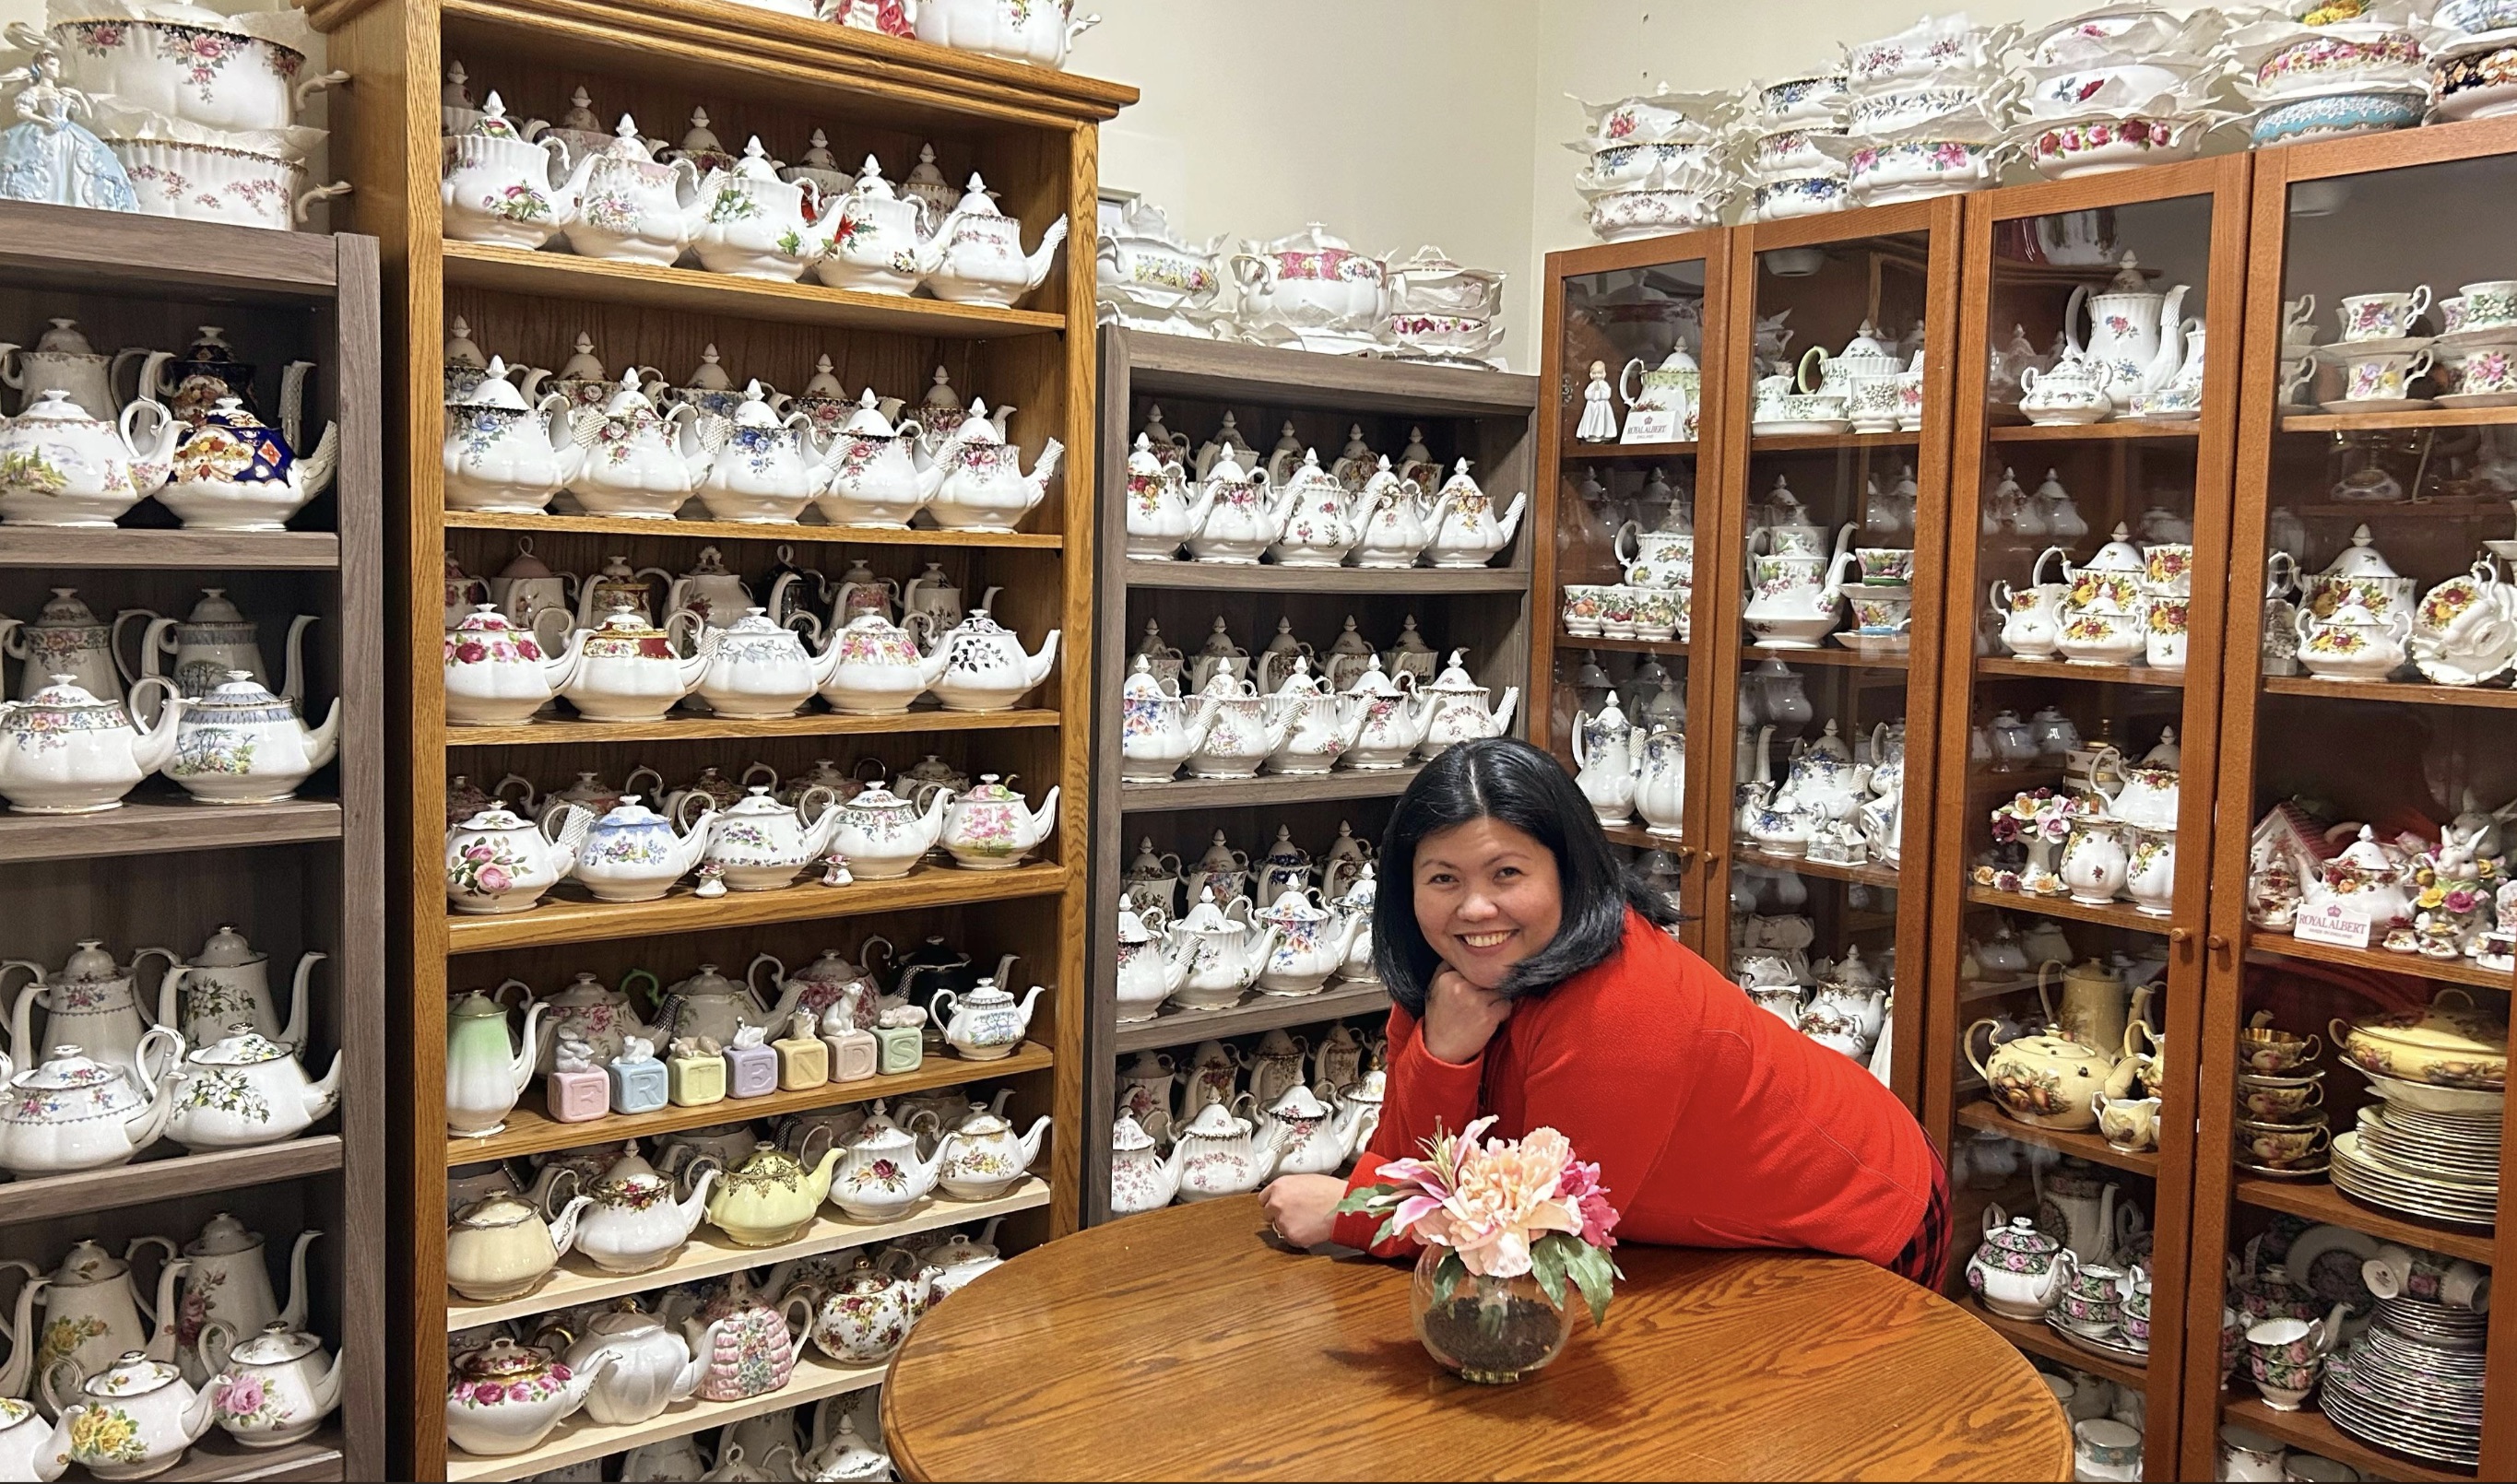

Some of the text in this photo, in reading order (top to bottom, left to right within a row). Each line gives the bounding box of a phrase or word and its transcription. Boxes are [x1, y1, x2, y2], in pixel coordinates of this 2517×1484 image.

[1627, 425, 1667, 434] ROYAL ALBERT
[2298, 913, 2367, 935] ROYAL ALBERT
